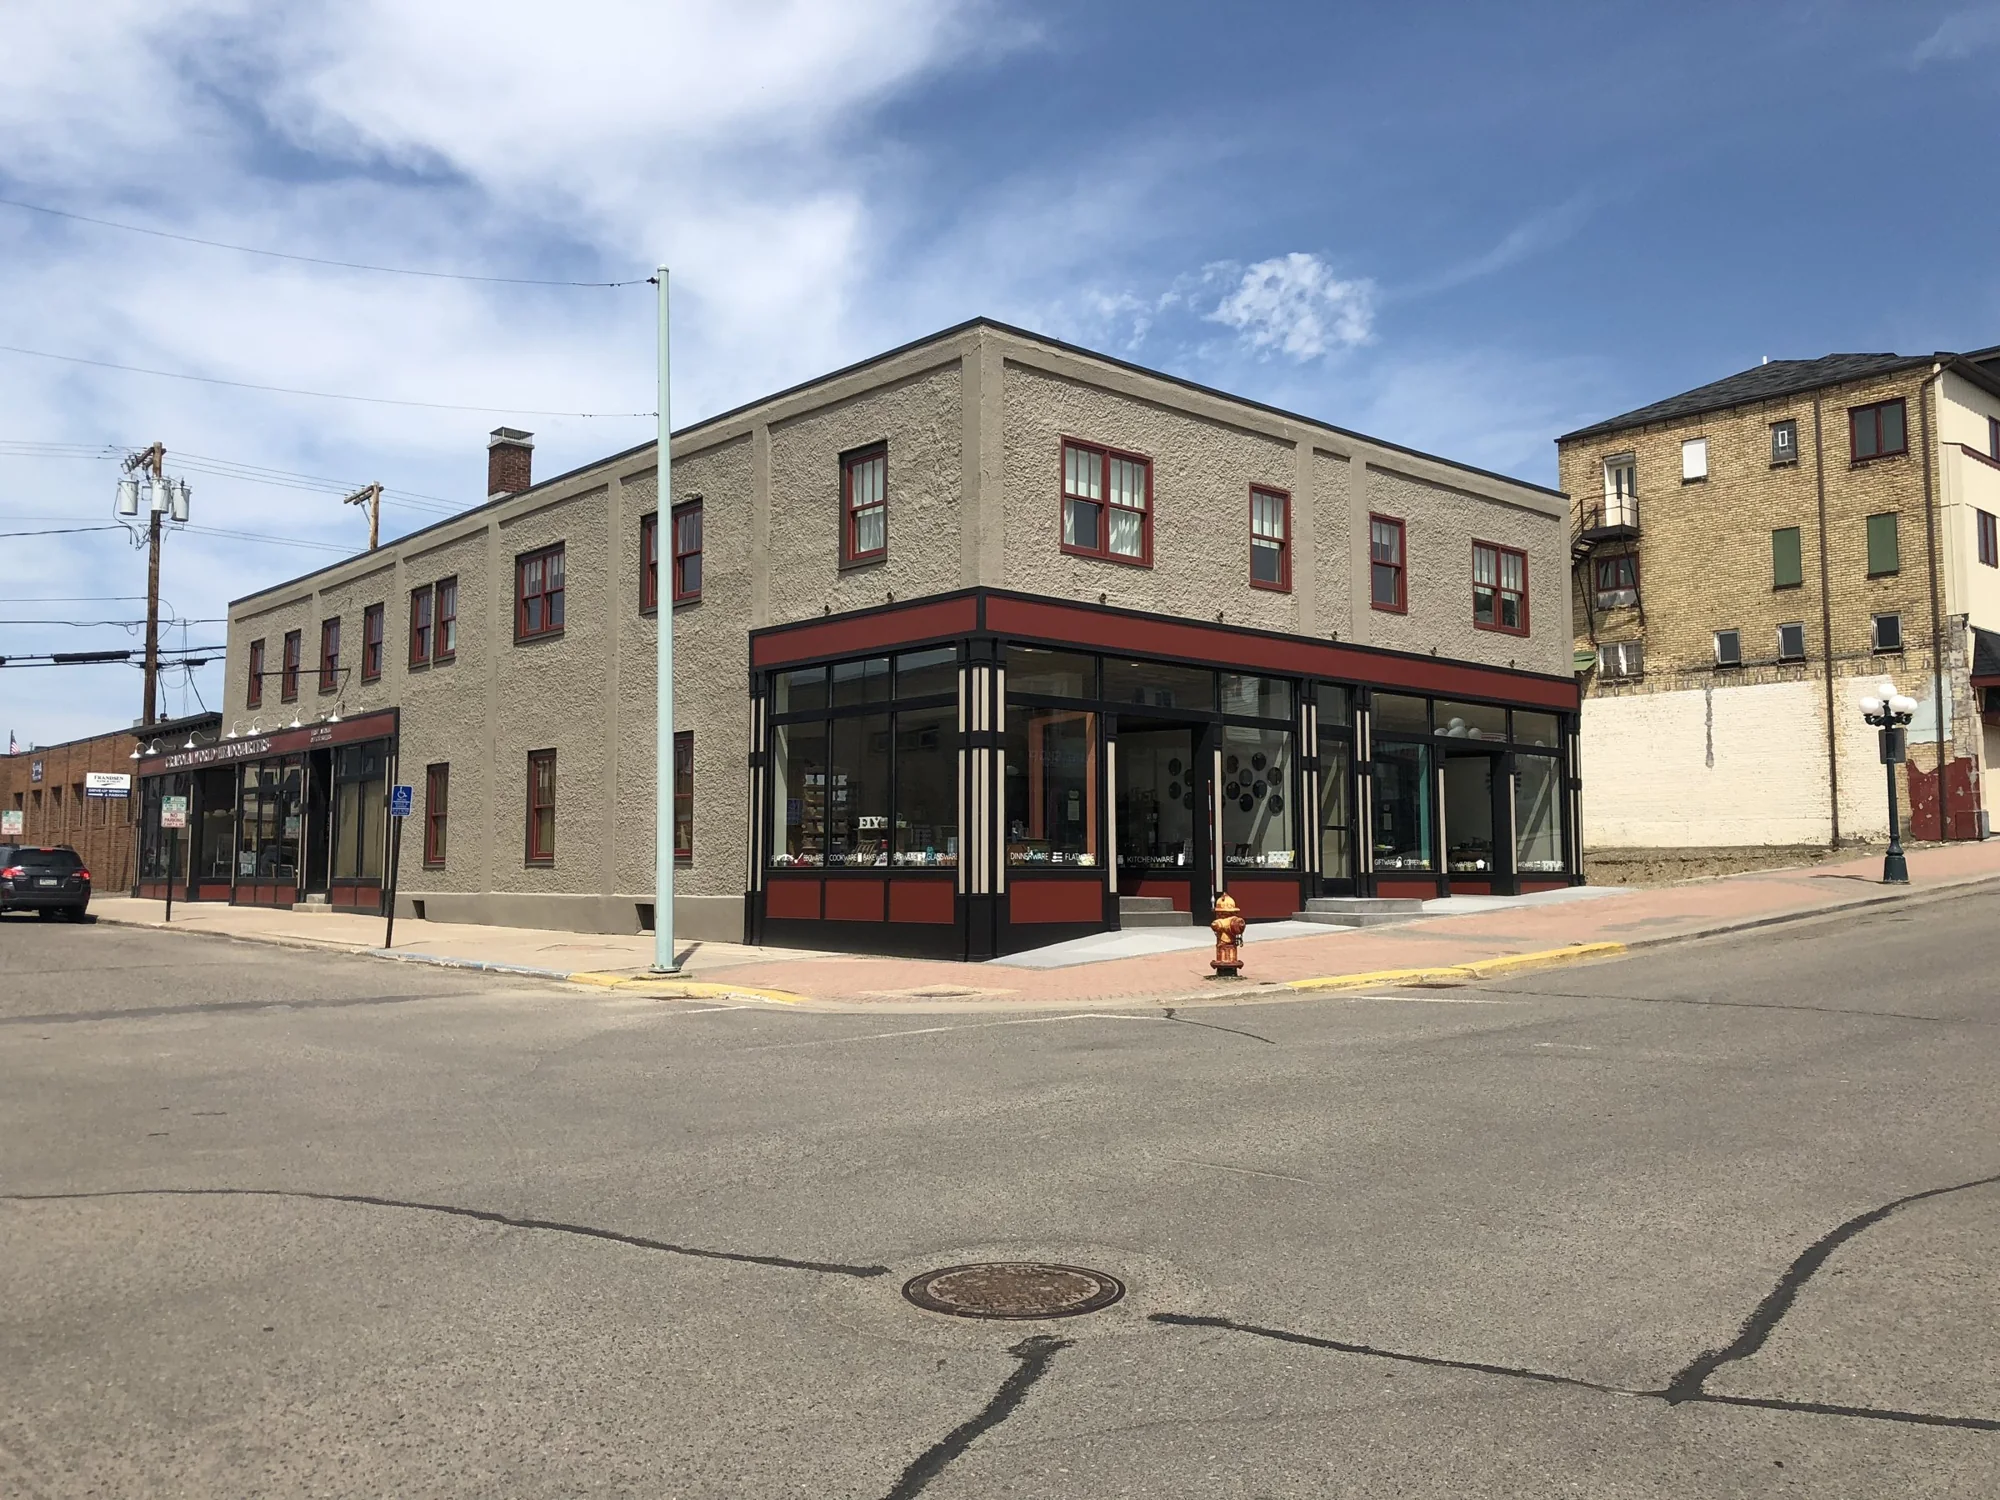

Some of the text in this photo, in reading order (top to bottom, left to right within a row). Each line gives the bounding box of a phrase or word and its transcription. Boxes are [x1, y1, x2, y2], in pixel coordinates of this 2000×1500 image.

[829, 853, 857, 862] COOKWARE
[1010, 852, 1049, 861] DINNERWARE
[1127, 855, 1174, 863] KITCHENWARE
